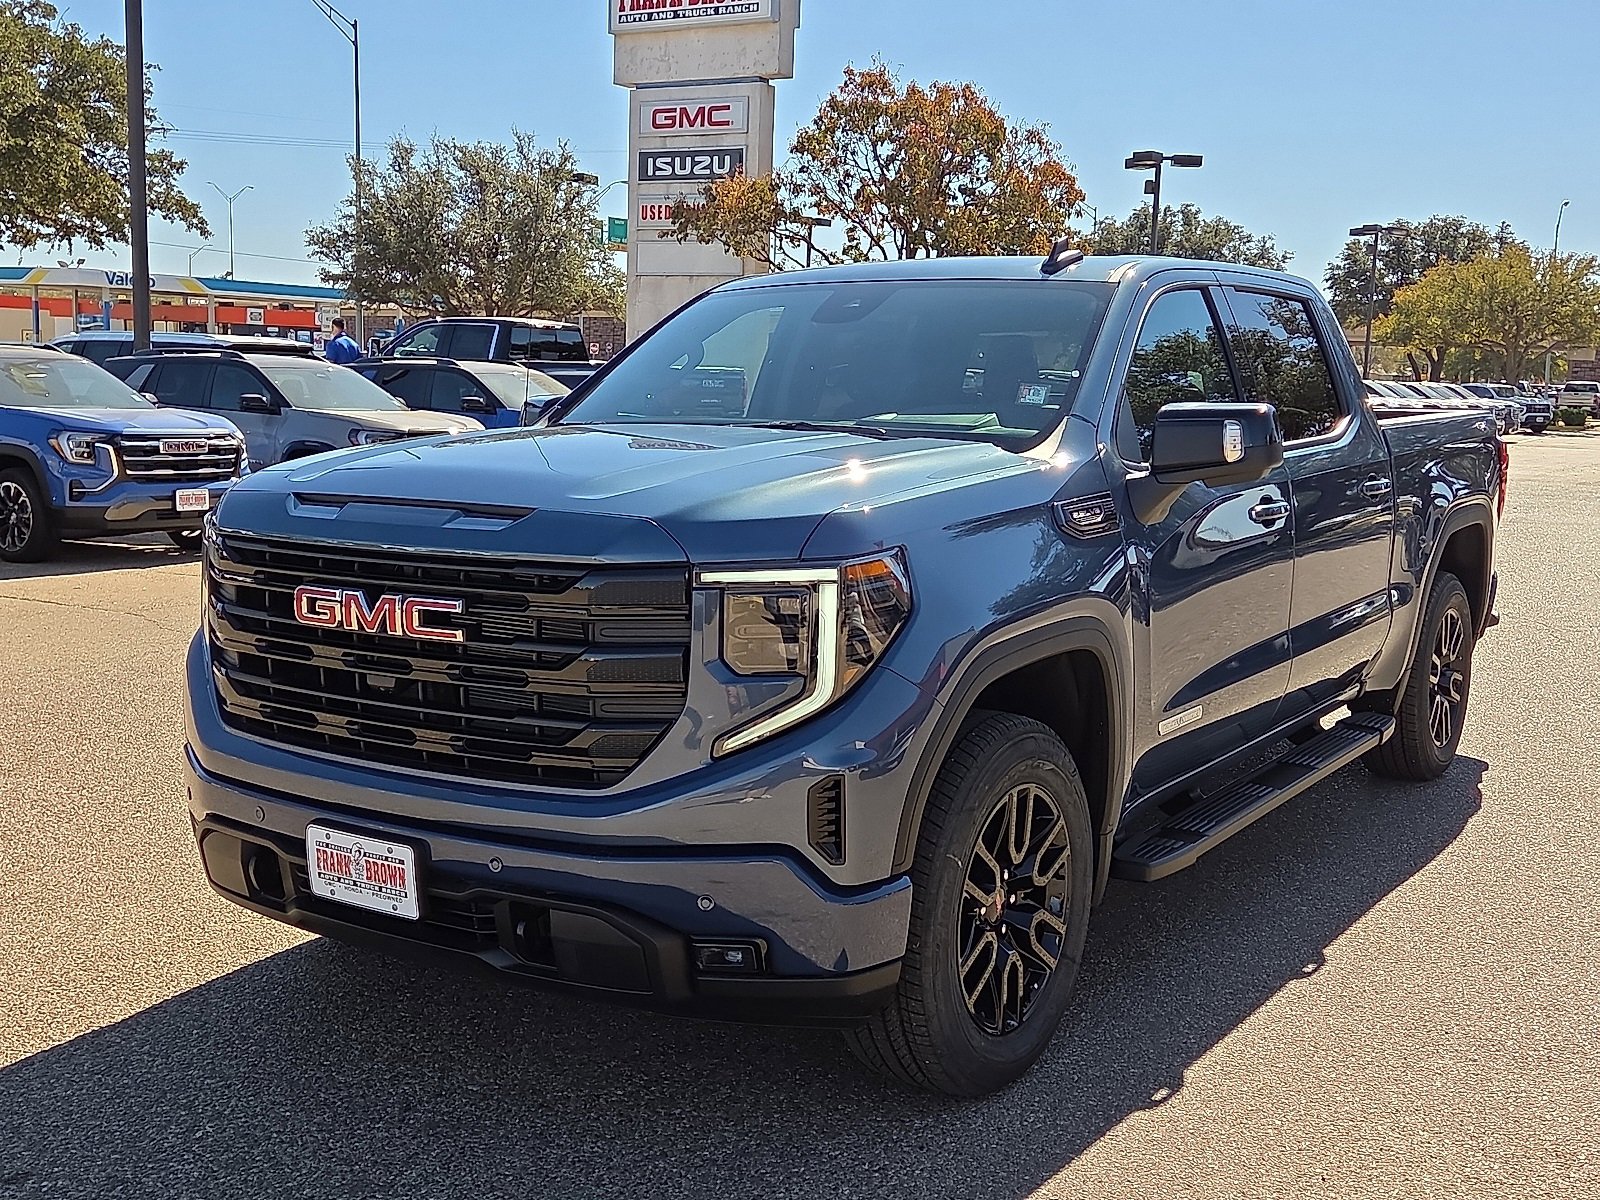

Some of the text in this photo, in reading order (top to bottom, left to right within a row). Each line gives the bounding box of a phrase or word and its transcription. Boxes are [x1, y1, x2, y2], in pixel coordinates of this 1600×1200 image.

[619, 4, 758, 23] AUTO AND TRUCK RANCH
[652, 105, 731, 129] GMC
[647, 155, 731, 176] ISUZU
[641, 204, 672, 220] USED
[105, 271, 156, 287] Valo
[294, 585, 464, 643] GMC
[316, 848, 406, 890] FRANK BROWN
[319, 872, 405, 898] AUTO AND TRUCK RANCH
